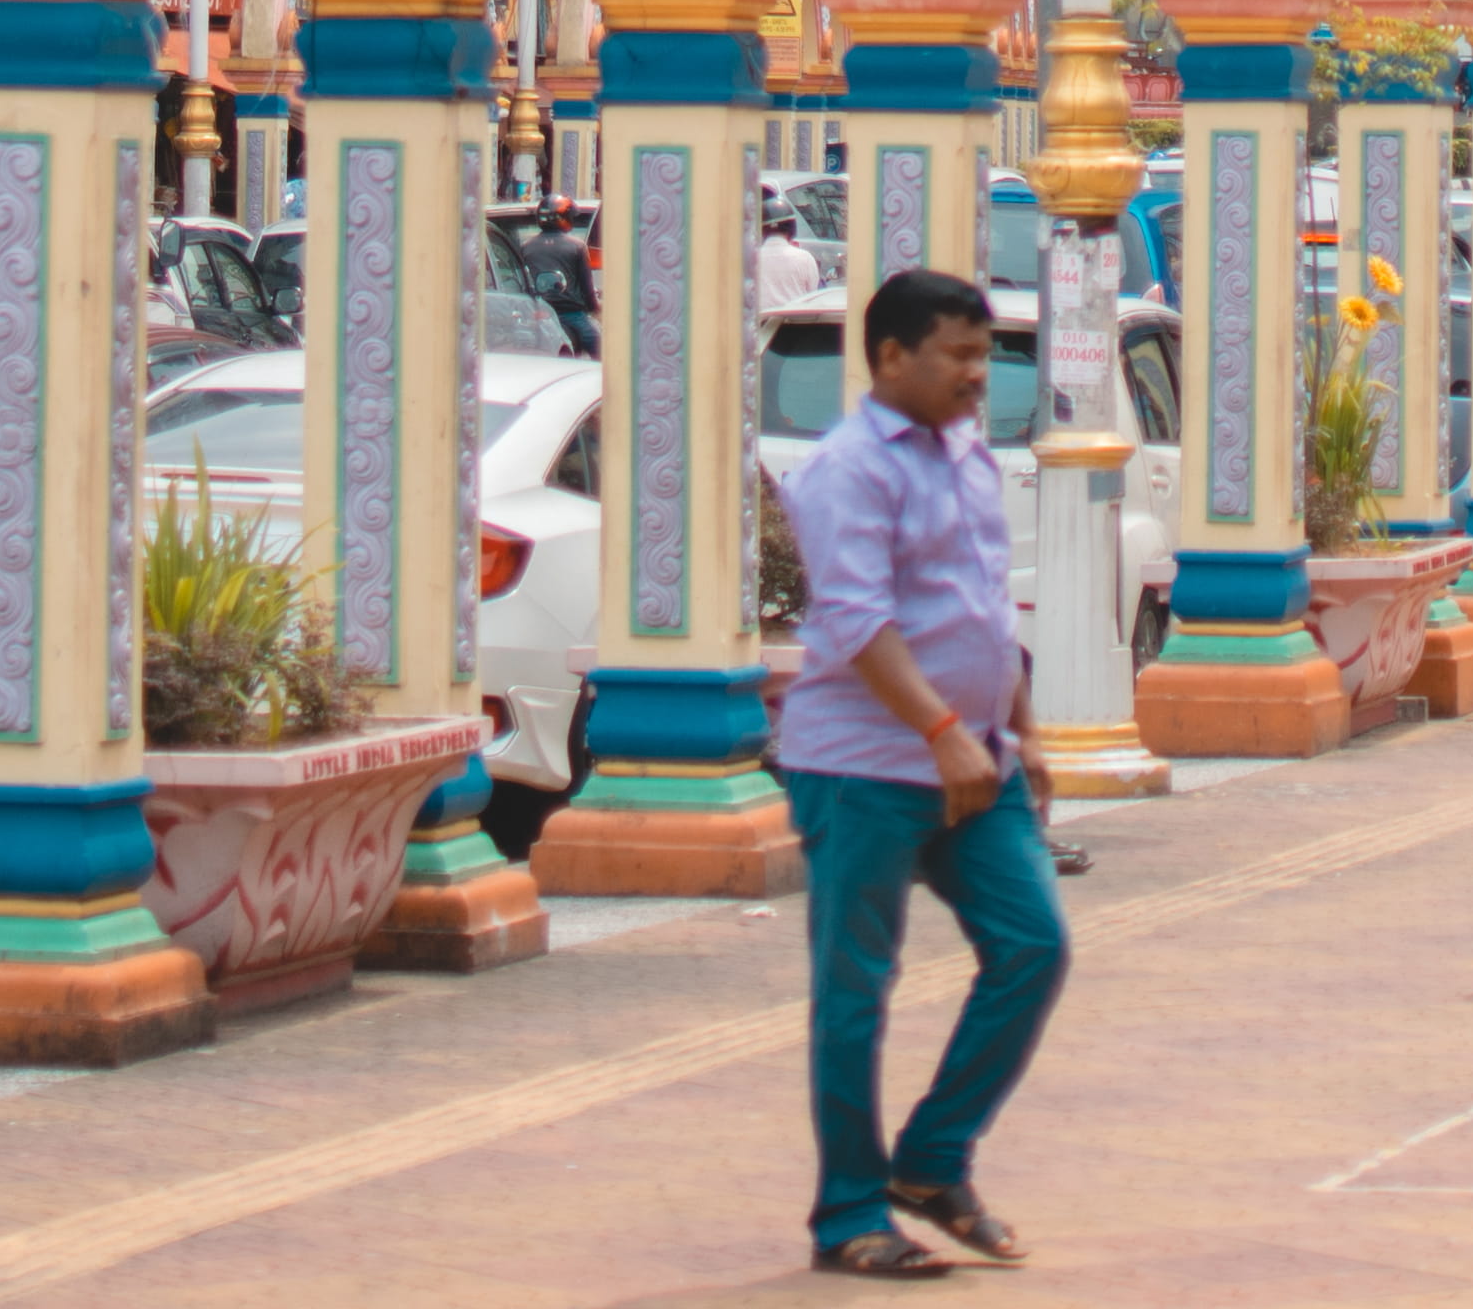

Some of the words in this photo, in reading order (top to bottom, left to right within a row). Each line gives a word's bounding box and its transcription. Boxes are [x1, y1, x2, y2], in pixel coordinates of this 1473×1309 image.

[302, 754, 350, 782] LITTLE
[356, 745, 395, 771] INDIA
[399, 728, 481, 761] BRICKFIELDS
